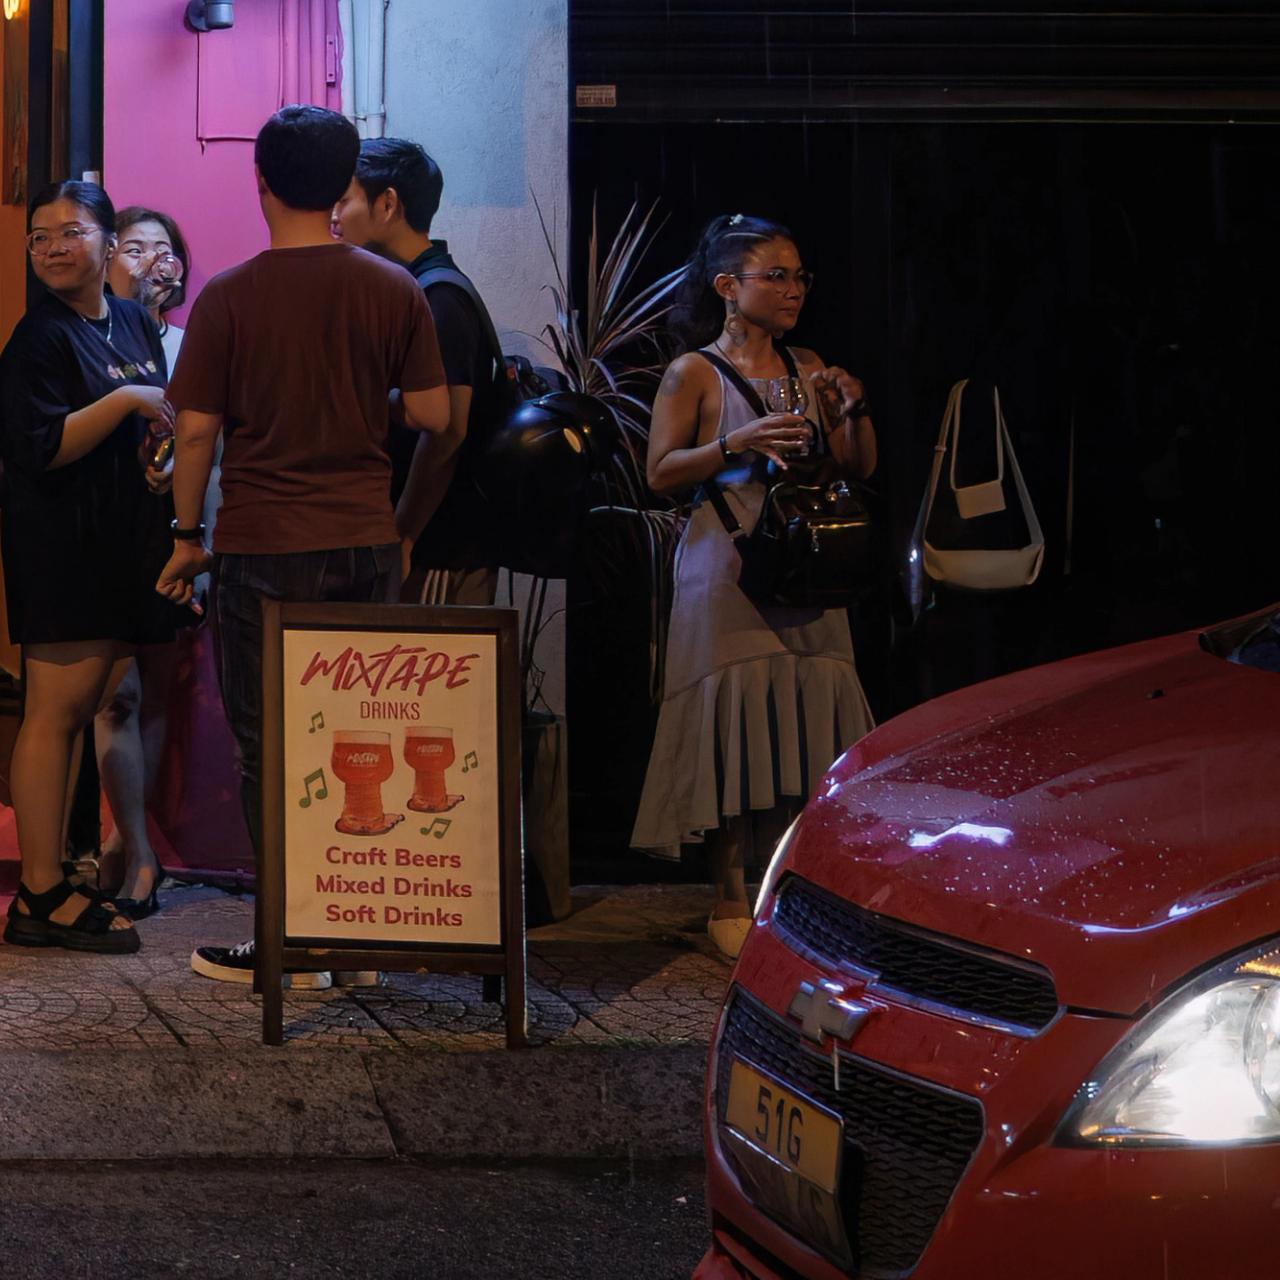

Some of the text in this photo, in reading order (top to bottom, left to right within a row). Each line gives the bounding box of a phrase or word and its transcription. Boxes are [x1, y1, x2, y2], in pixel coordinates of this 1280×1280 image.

[360, 701, 421, 720] DRINKS
[326, 846, 462, 869] Craft Beers
[316, 874, 473, 898] Mixed Drinks
[326, 904, 464, 927] Soft Drinks
[756, 1086, 803, 1166] 51G
